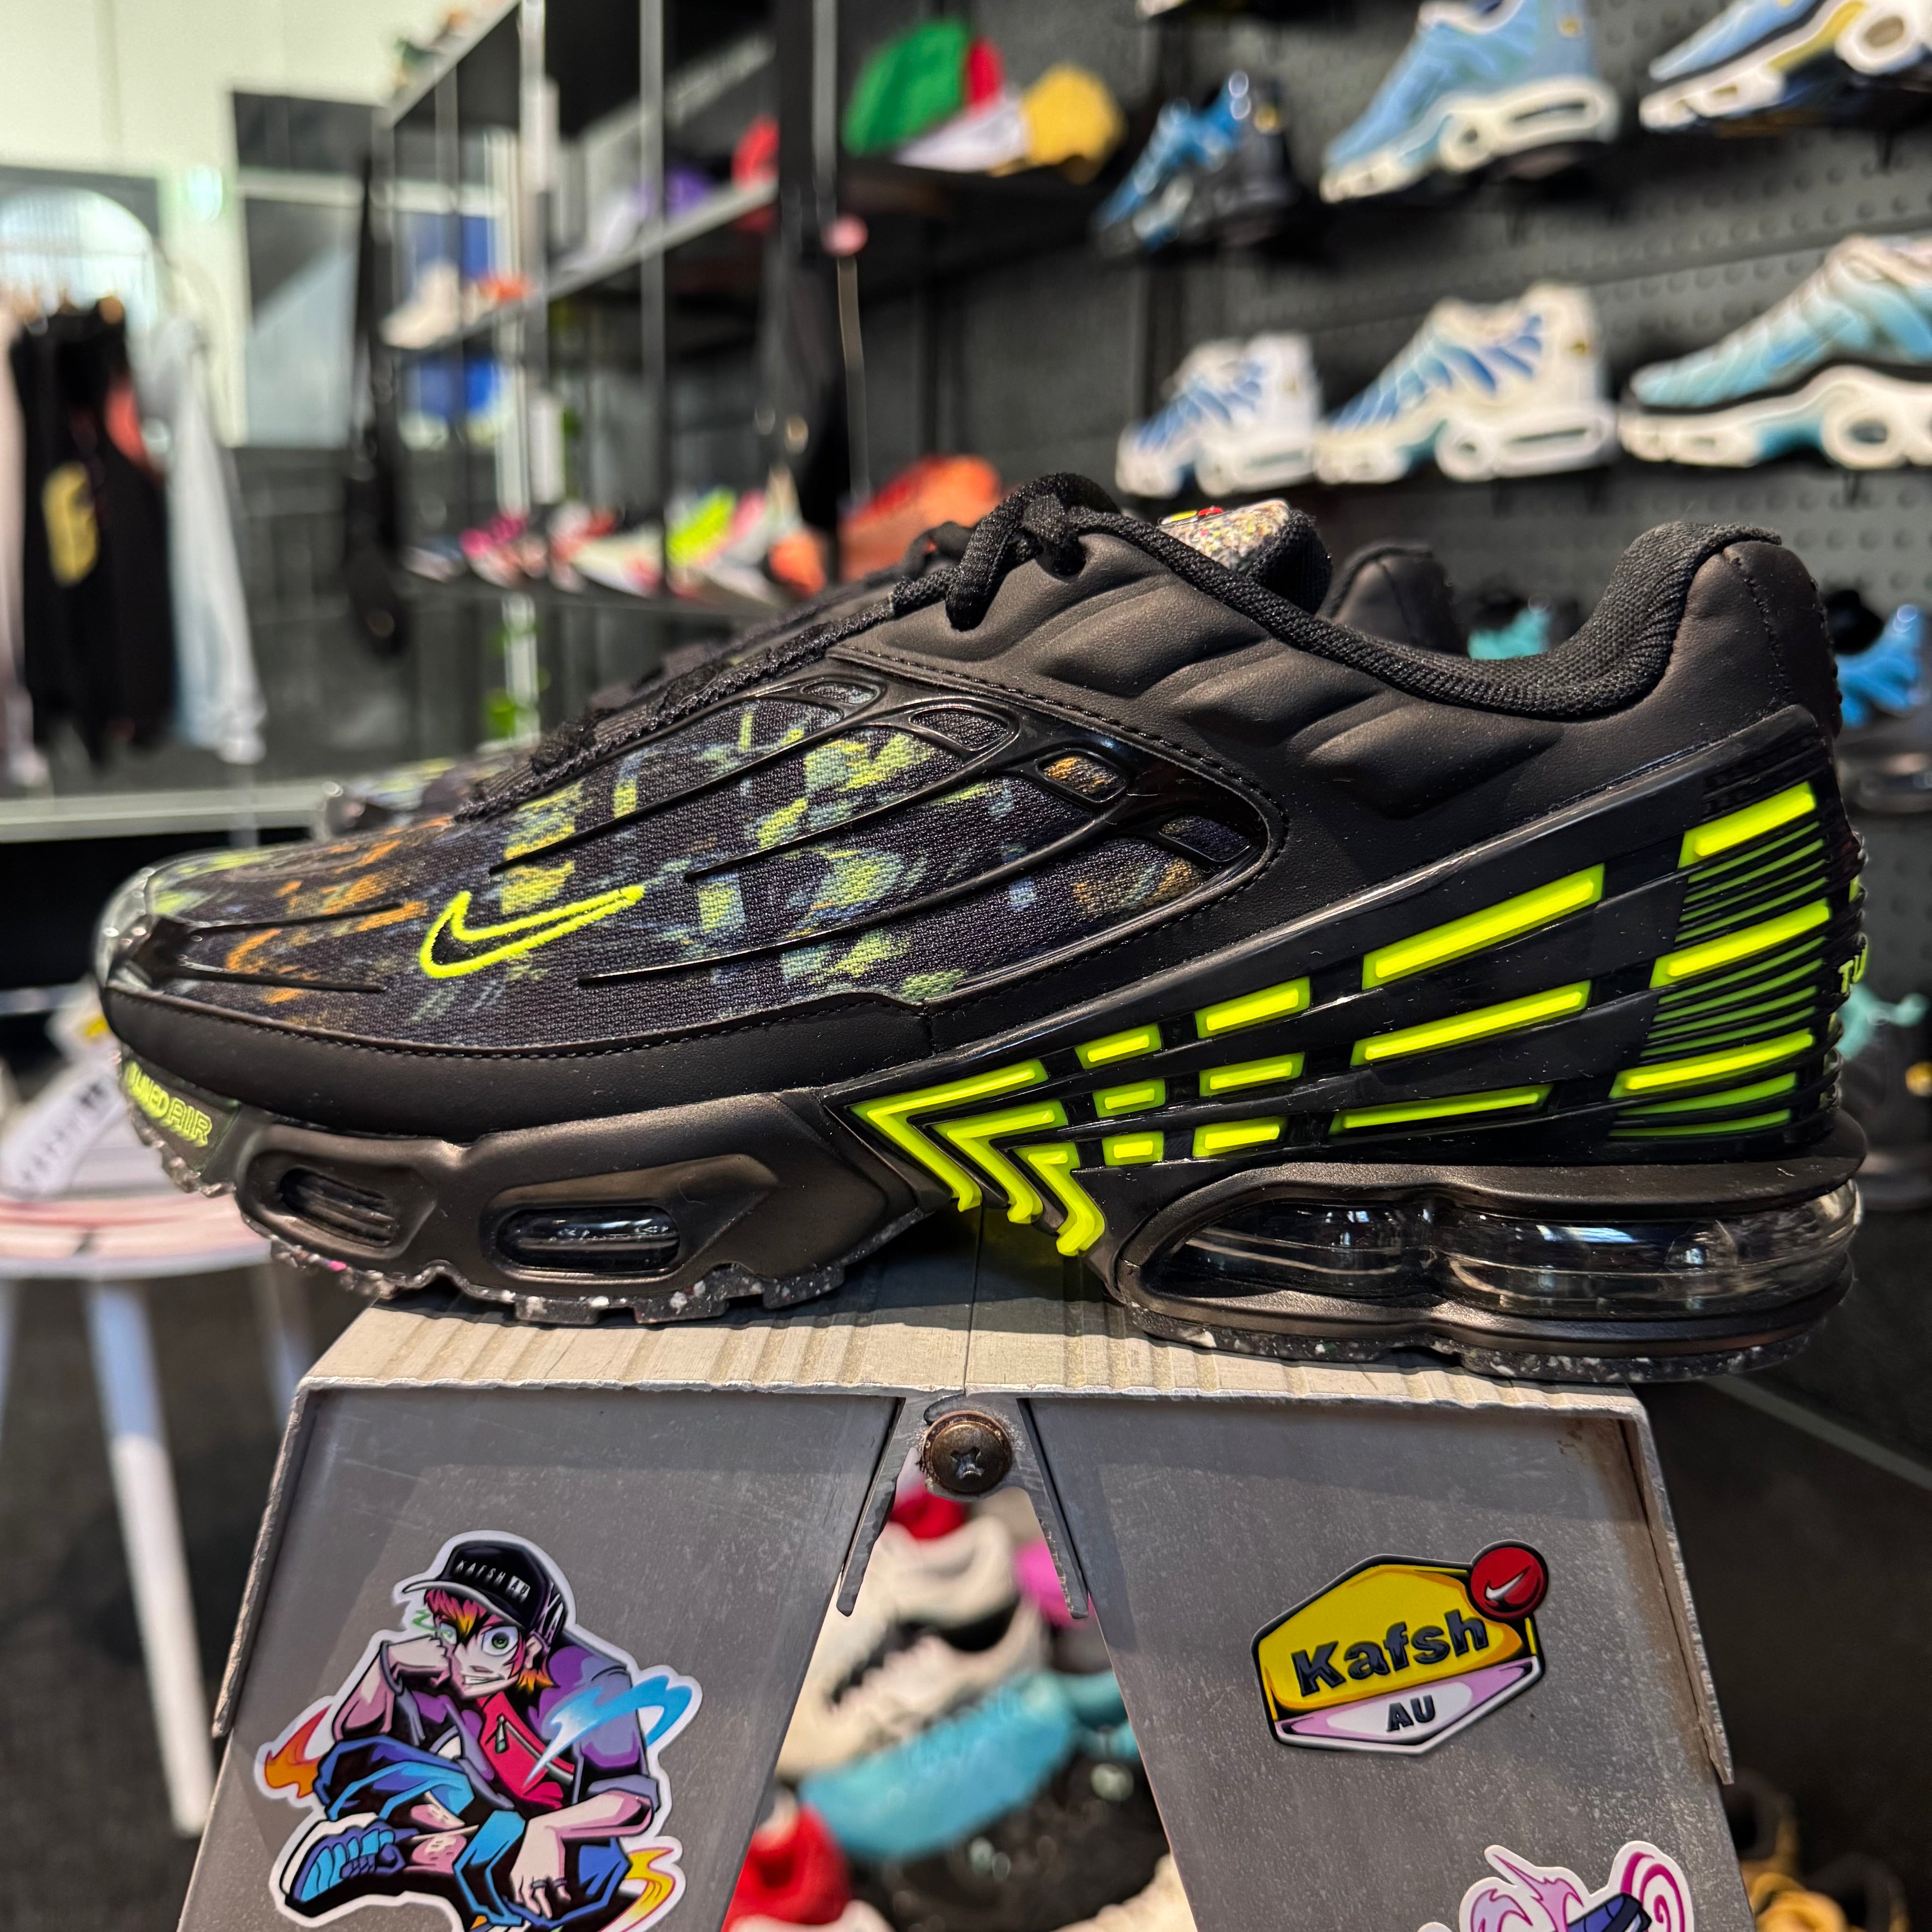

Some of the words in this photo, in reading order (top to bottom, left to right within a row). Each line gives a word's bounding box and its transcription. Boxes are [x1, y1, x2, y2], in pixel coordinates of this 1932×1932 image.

[160, 1097, 213, 1148] AIR
[1291, 1609, 1489, 1697] Kafsh
[1386, 1695, 1436, 1732] AU
